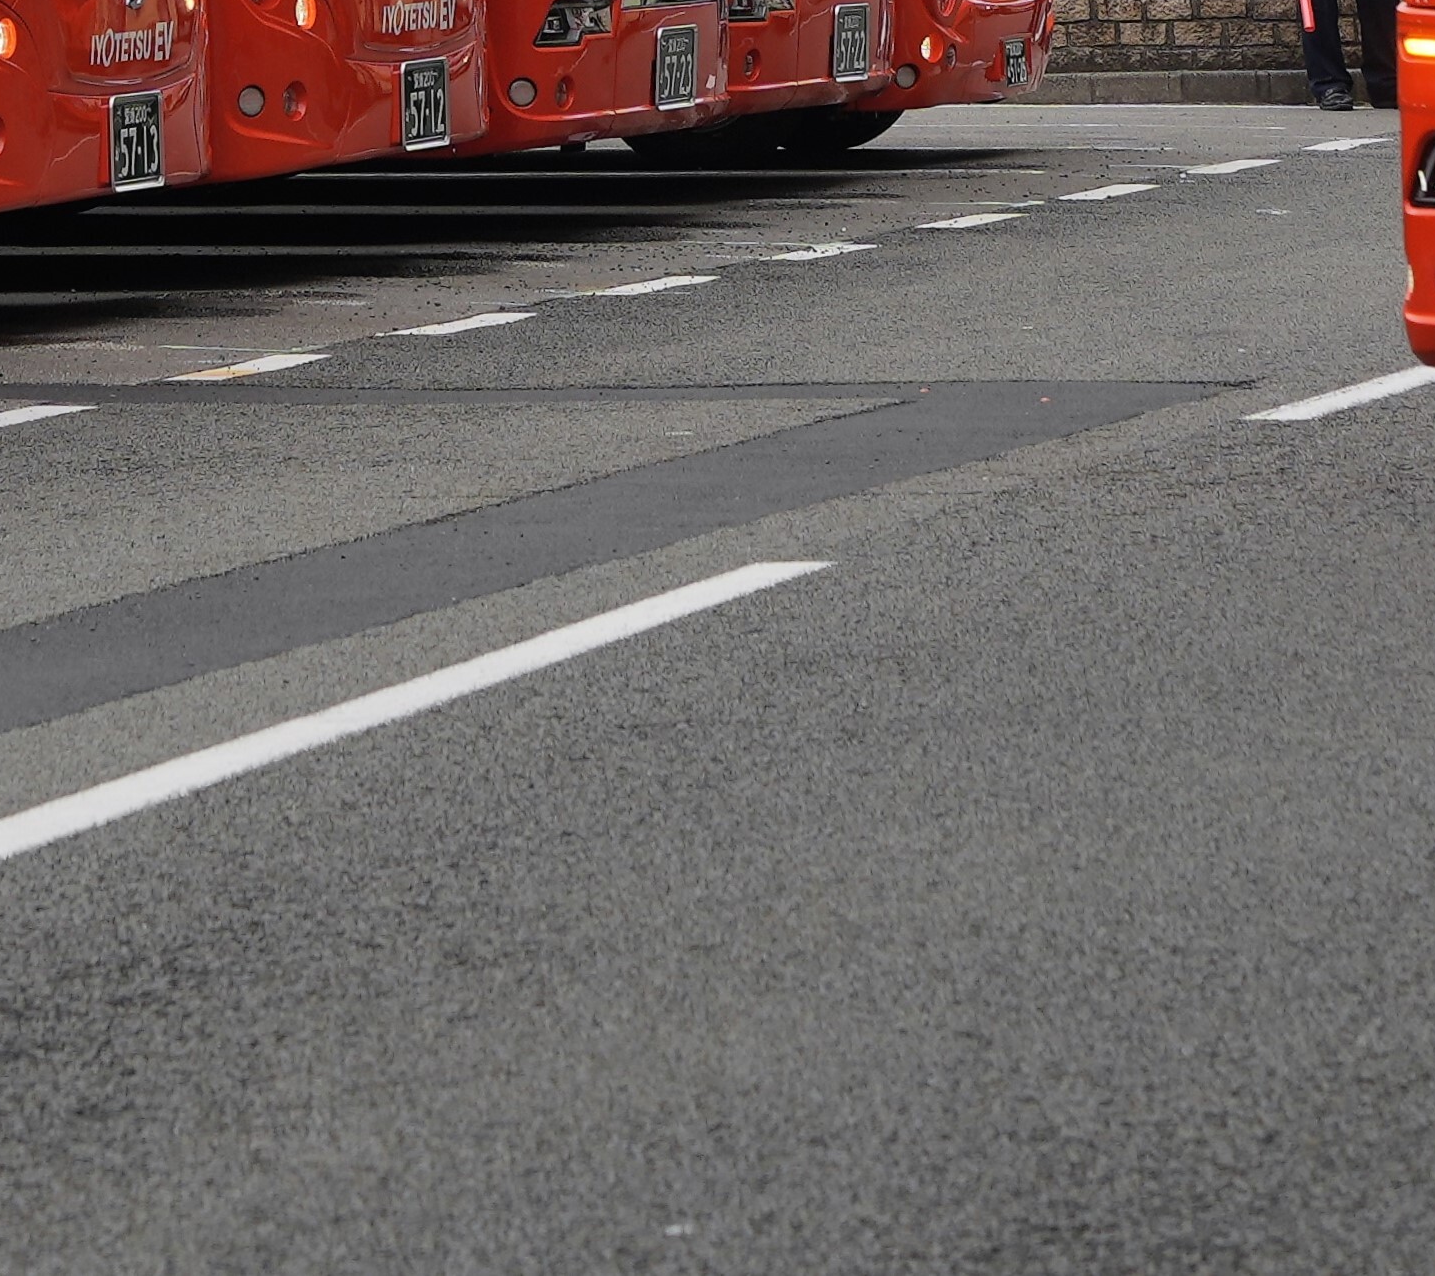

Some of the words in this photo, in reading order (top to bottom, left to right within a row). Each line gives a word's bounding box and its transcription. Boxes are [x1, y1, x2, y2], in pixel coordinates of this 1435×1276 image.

[382, 0, 437, 36] IYOTETSU
[91, 28, 152, 67] IYOTETSU
[154, 20, 174, 62] EV
[410, 89, 445, 137] 57-12
[120, 124, 158, 177] 57-13
